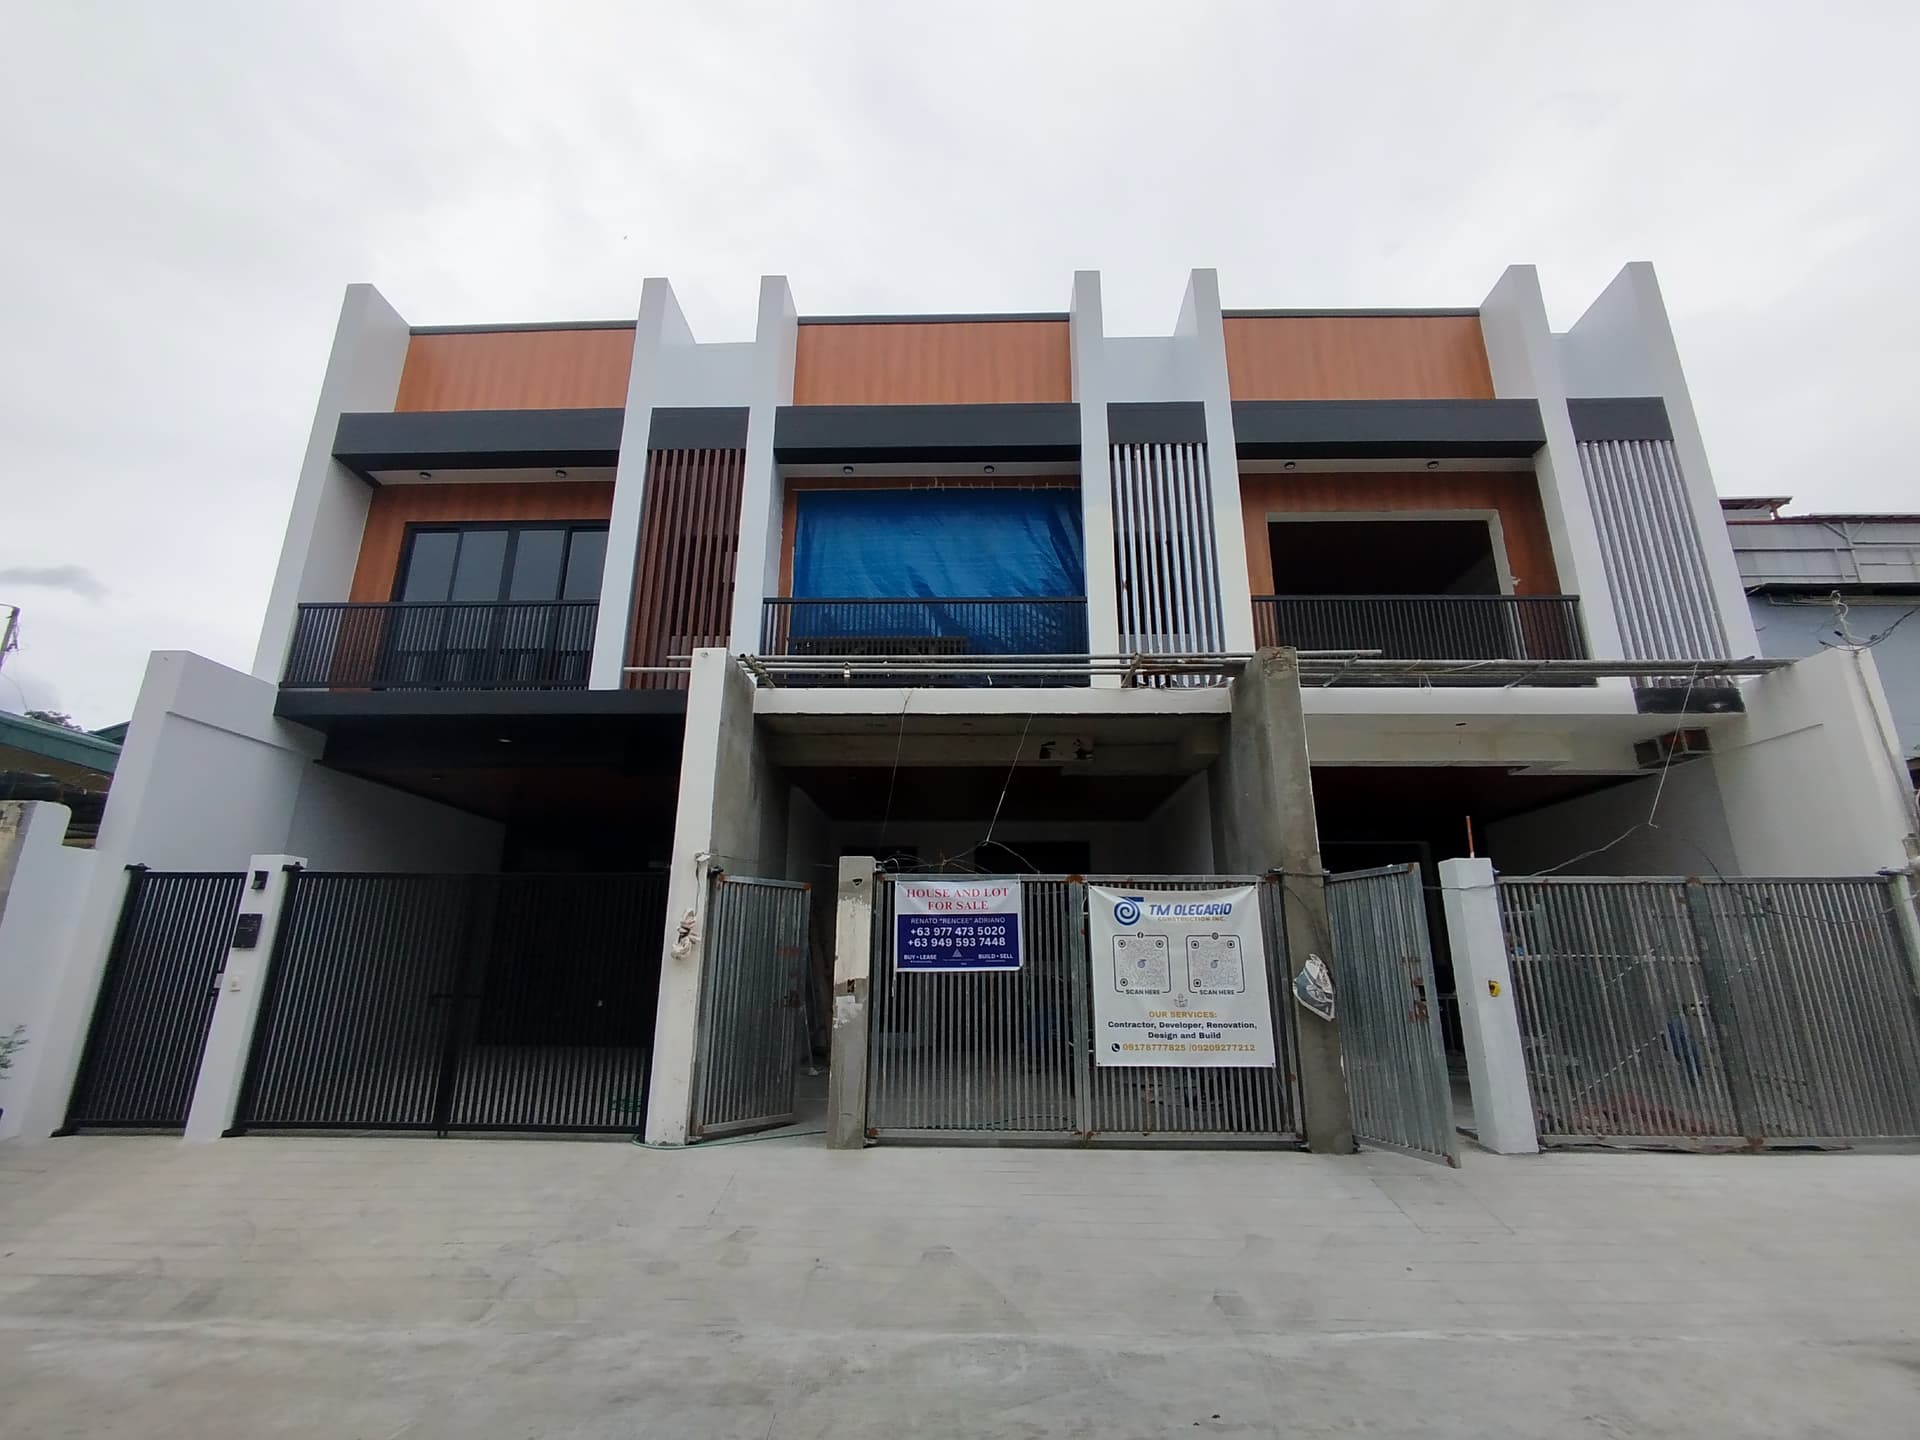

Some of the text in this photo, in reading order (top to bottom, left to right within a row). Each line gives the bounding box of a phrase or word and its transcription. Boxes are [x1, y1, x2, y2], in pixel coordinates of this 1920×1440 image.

[907, 888, 1008, 898] HOUSE AND LOT
[928, 901, 989, 910] FOR SALE
[1149, 903, 1232, 915] TM OLEGARIO
[910, 926, 1006, 936] +63 977 473 5020
[908, 937, 1006, 947] +63 949 593 7448
[1108, 1021, 1156, 1029] Contractor,
[1159, 1022, 1204, 1030] Developer,
[1148, 1032, 1178, 1040] Design
